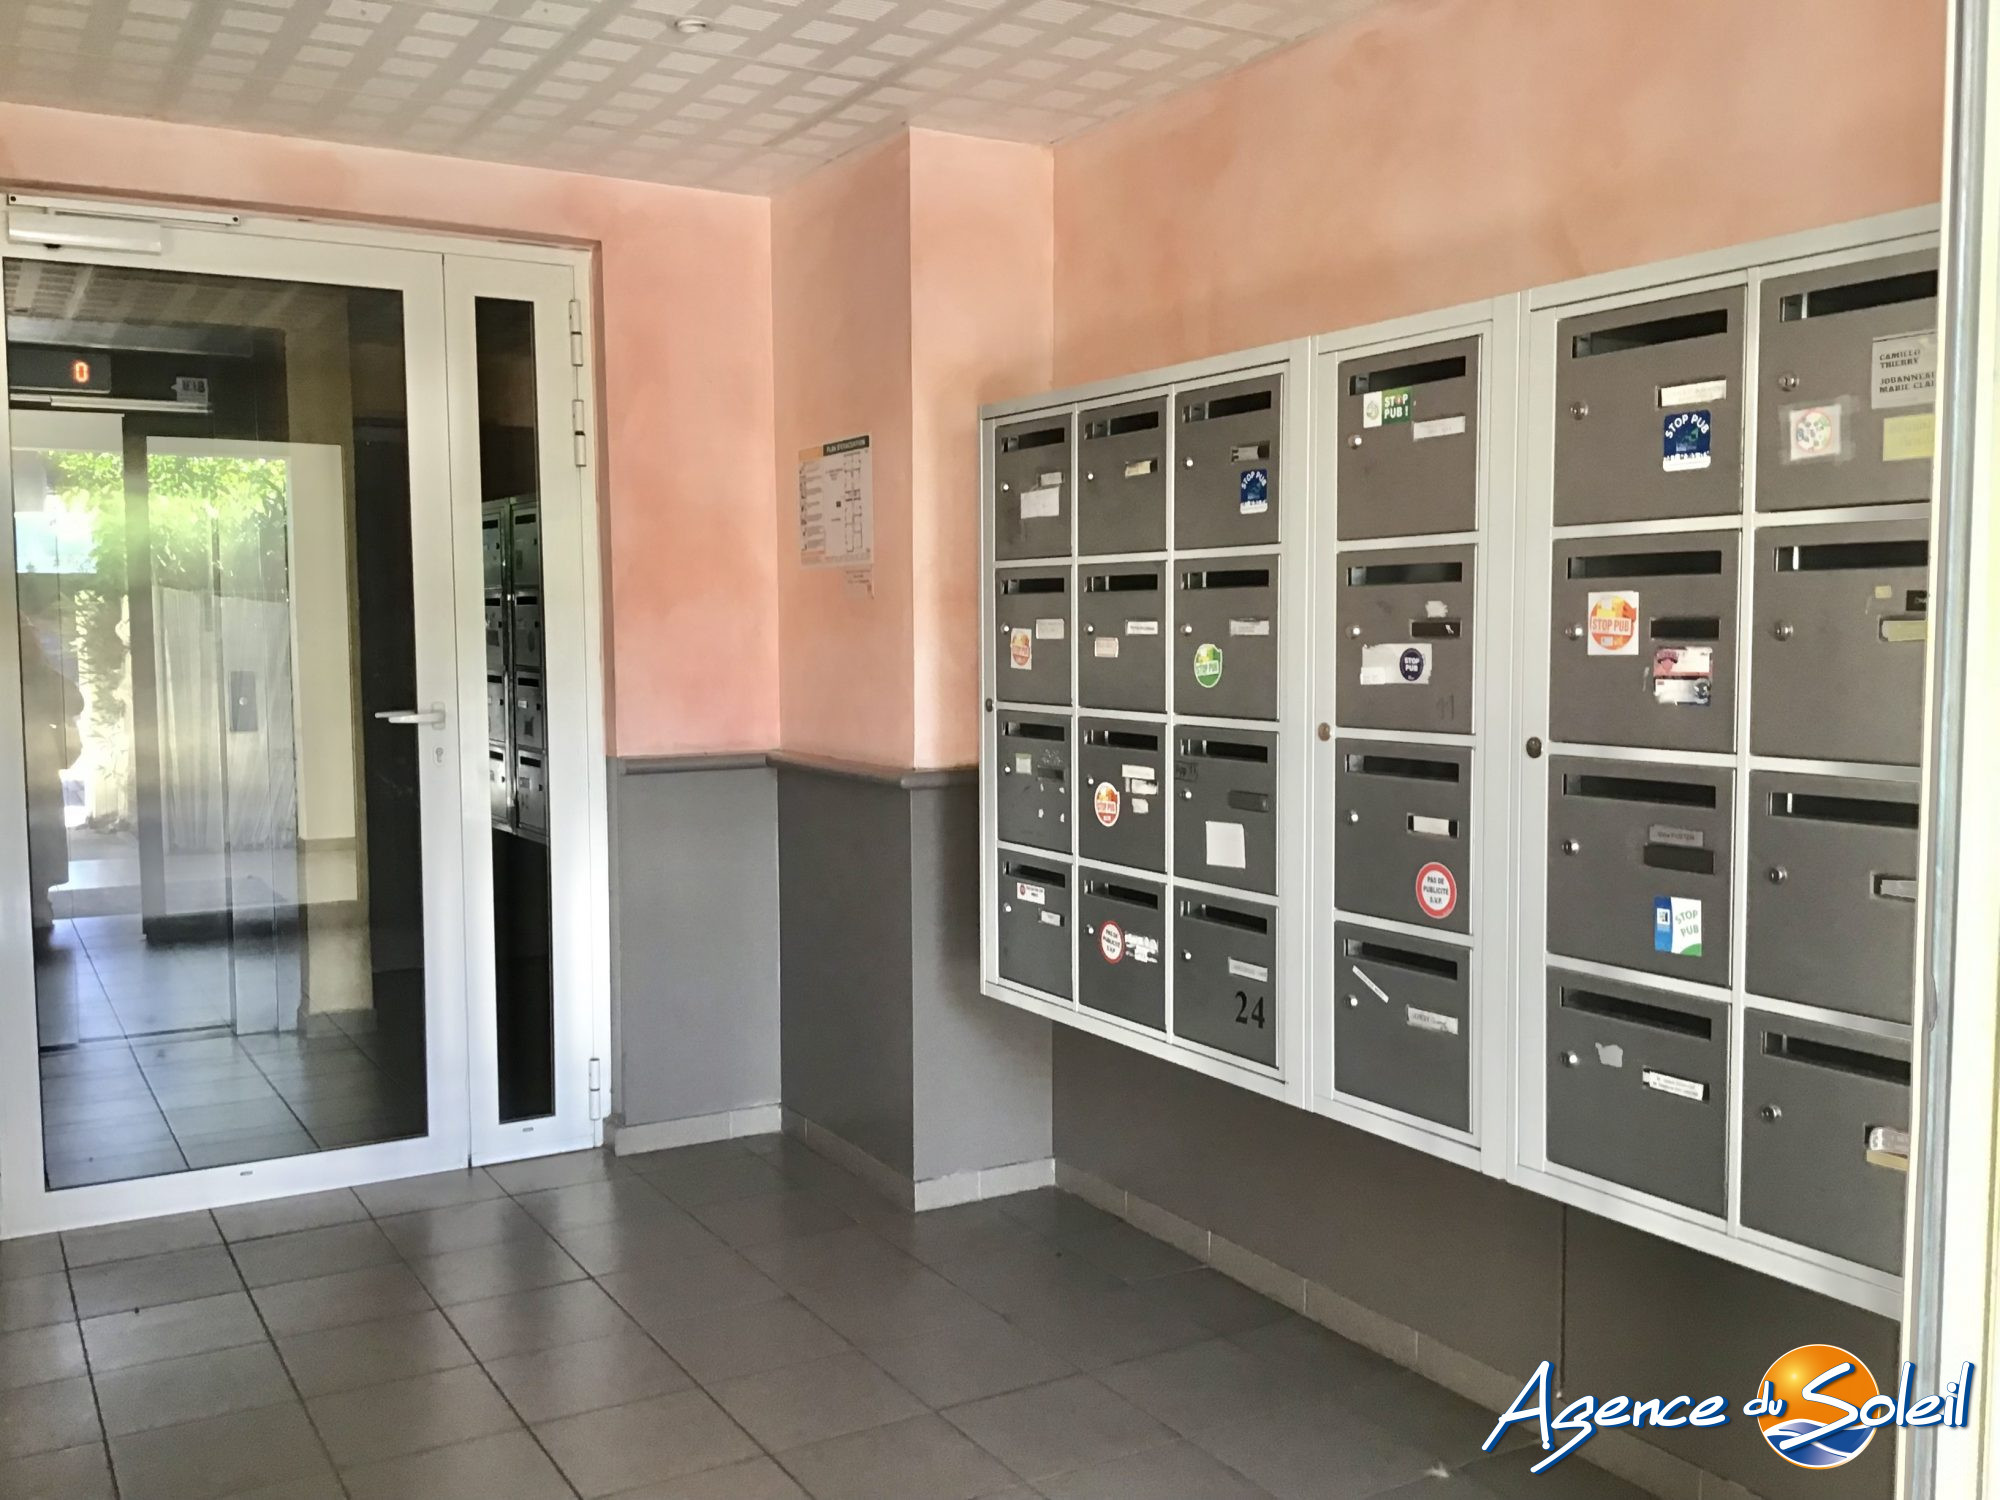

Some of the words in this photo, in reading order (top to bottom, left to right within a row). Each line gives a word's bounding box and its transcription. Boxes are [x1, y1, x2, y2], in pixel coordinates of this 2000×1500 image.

[1384, 406, 1402, 419] PUB
[1665, 414, 1689, 439] STOP
[1690, 413, 1710, 434] PUB
[1241, 471, 1255, 490] STOP
[1592, 619, 1612, 631] STOP
[1613, 621, 1630, 632] PUB
[1404, 656, 1420, 665] STOP
[1405, 664, 1419, 672] PUB
[1427, 876, 1437, 884] PAS
[1437, 877, 1445, 885] DE
[1675, 909, 1698, 924] STOP
[1680, 924, 1700, 937] PUB
[1234, 990, 1266, 1029] 24
